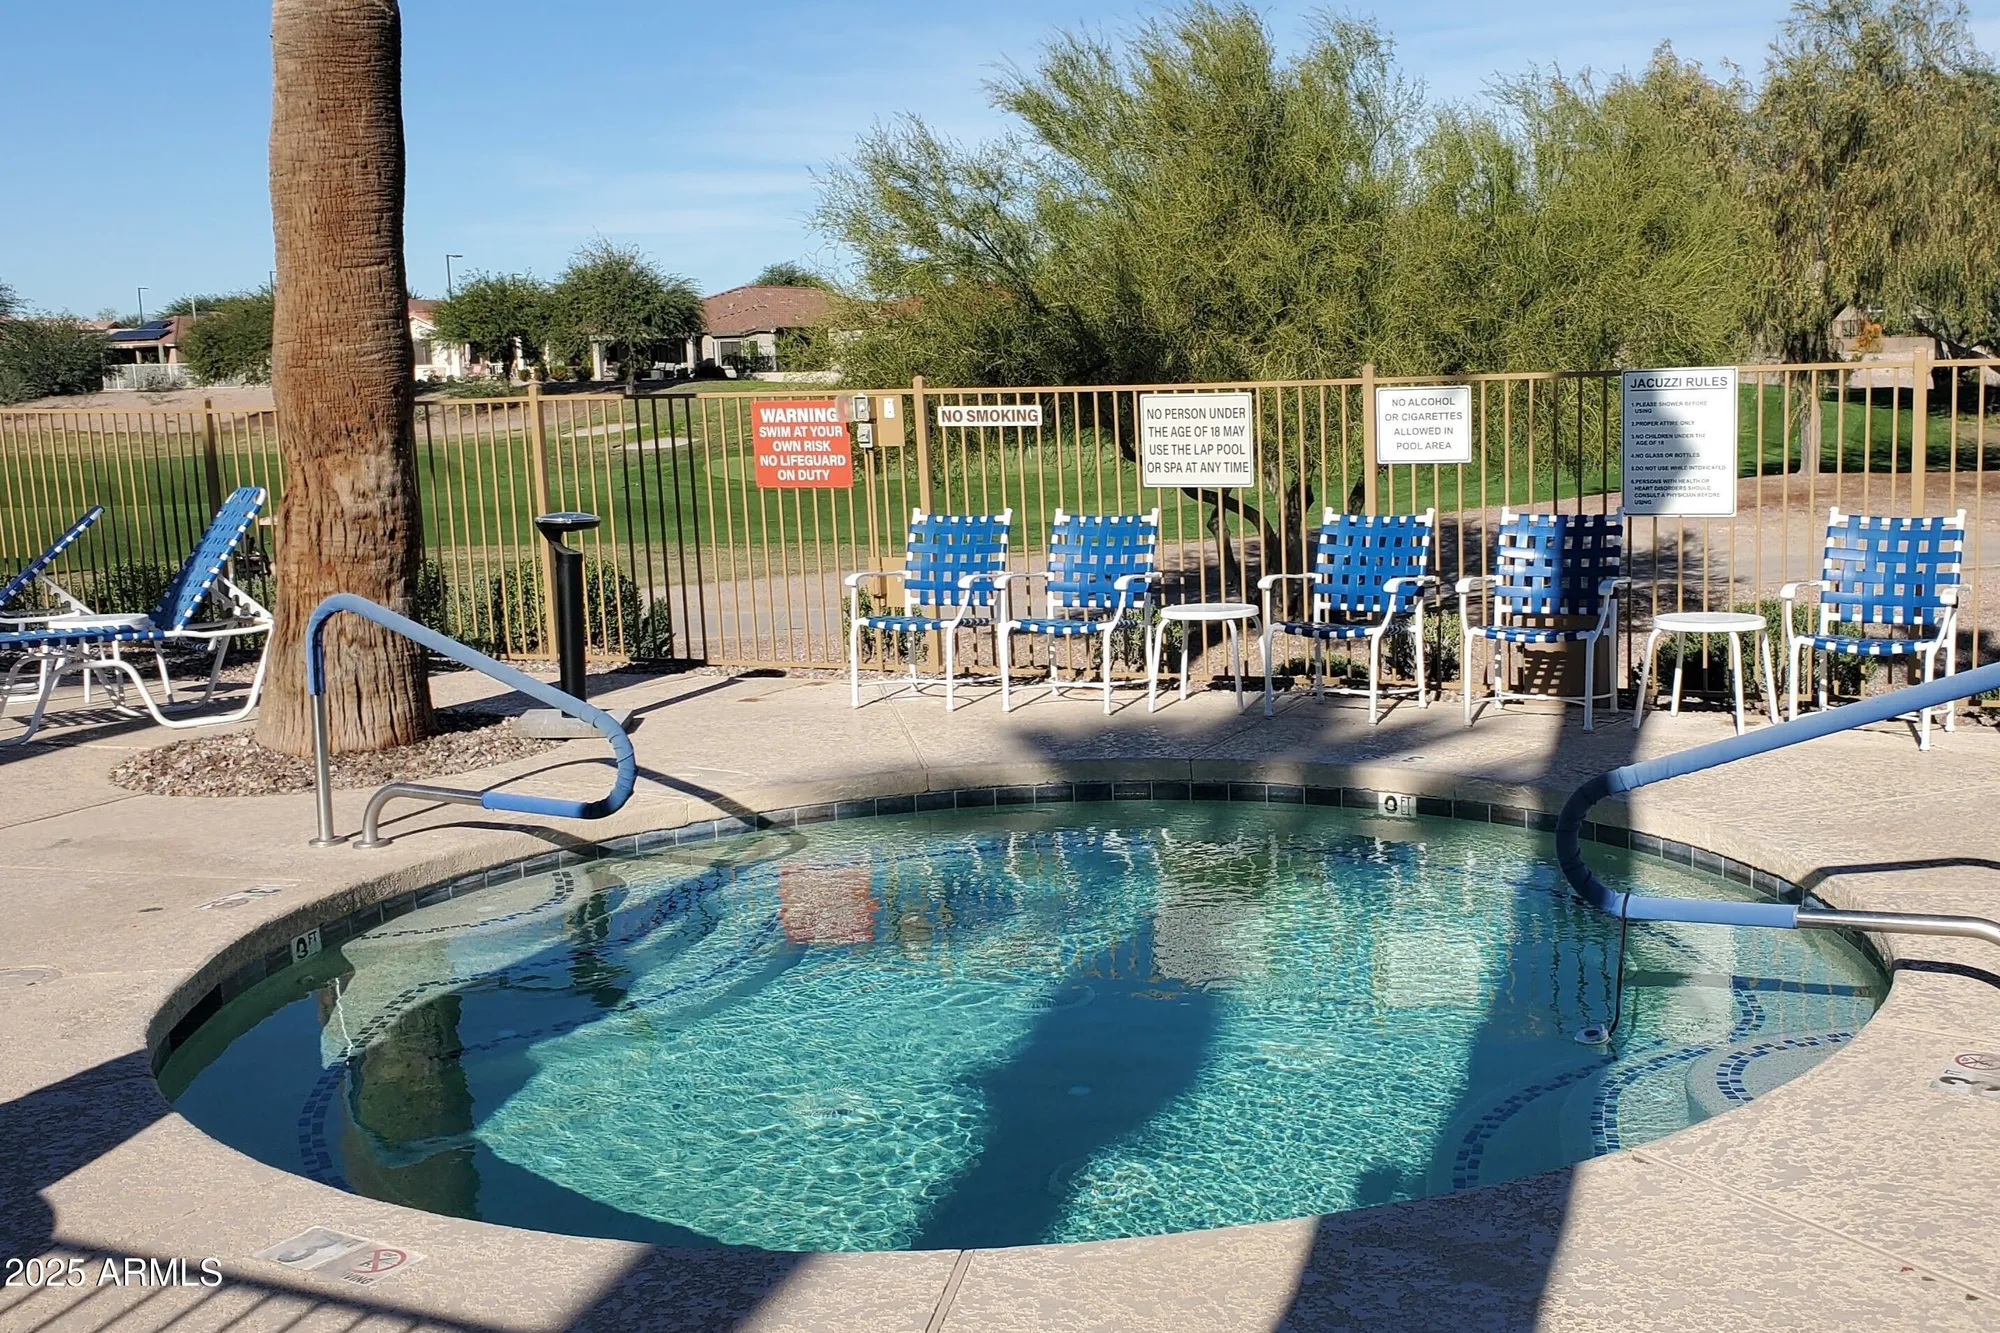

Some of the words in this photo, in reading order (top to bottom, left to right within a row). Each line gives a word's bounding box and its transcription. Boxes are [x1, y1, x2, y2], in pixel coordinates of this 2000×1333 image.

[1630, 377, 1682, 388] JACUZZI
[1686, 376, 1728, 387] RULES
[1392, 398, 1406, 406] NO
[1408, 397, 1456, 406] ALCOHOL
[760, 408, 838, 423] WARNING
[941, 410, 963, 422] NO
[966, 409, 1039, 422] SMOKING
[1146, 408, 1162, 420] NO
[1164, 408, 1206, 420] PERSON
[1209, 407, 1246, 419] UNDER
[1384, 413, 1398, 422] OR
[1402, 412, 1463, 421] CIGARETTES
[759, 426, 791, 438] SWIM
[794, 426, 808, 437] AT
[810, 426, 843, 437] YOUR
[1148, 426, 1168, 438] THE
[1170, 426, 1192, 438] AGE
[1194, 426, 1208, 438] OF
[1210, 426, 1220, 437] 18
[1223, 426, 1245, 437] MAY
[1394, 427, 1442, 436] ALLOWED
[773, 440, 802, 452] OWN
[804, 440, 832, 452] RISK
[1149, 444, 1168, 456] USE
[1171, 444, 1192, 456] THE
[1194, 444, 1214, 456] LAP
[1216, 444, 1246, 455] POOL
[1396, 442, 1423, 450] POOL
[1424, 442, 1452, 450] AREA
[760, 455, 777, 466] NO
[780, 454, 846, 466] LIFEGUARD
[1146, 462, 1161, 473] OR
[1164, 462, 1183, 473] SPA
[1185, 462, 1198, 473] AT
[1200, 462, 1222, 473] ANY
[1223, 462, 1249, 473] TIME
[777, 470, 795, 480] ON
[798, 470, 830, 480] DUTY
